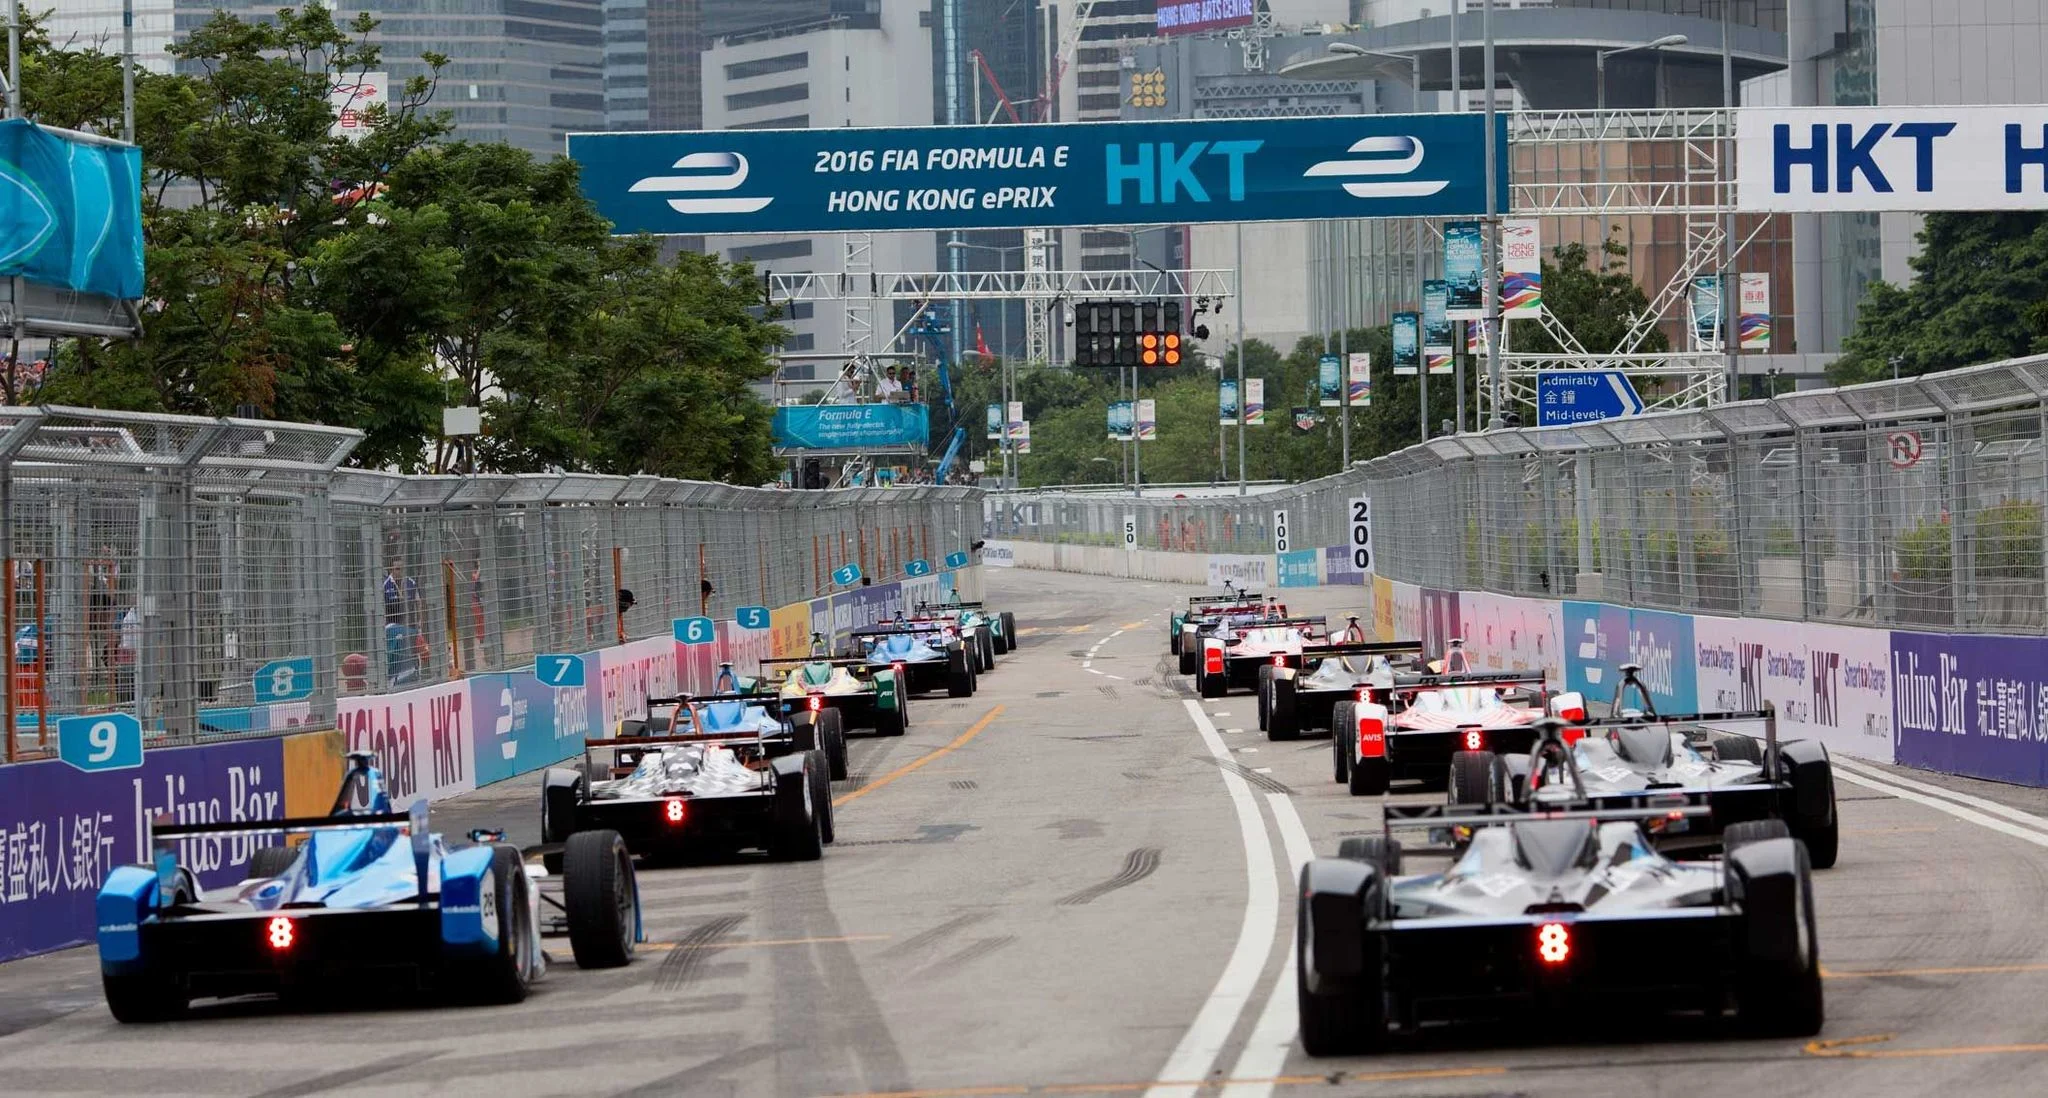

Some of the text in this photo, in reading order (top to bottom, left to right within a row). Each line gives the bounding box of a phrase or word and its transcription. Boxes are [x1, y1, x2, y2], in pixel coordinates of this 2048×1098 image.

[1157, 0, 1253, 28] HONG KONG ARTS CENTRE
[814, 145, 1069, 173] 2016 FIA FORMULA E
[1773, 122, 1958, 194] HKT
[1106, 140, 1265, 205] HKT
[828, 186, 1057, 213] HONG KONG ePRIX
[1542, 375, 1599, 387] Admiralty
[1543, 390, 1576, 404] 金鐘
[819, 408, 872, 421] Formula E
[1545, 408, 1606, 420] Mid-levels
[1125, 522, 1135, 544] 50
[1277, 512, 1287, 551] 100
[1353, 501, 1370, 569] 200
[913, 562, 923, 575] 2
[952, 554, 959, 564] 1
[842, 567, 853, 581] 3
[687, 620, 702, 640] 6
[748, 609, 761, 626] 5
[272, 666, 294, 696] 8
[553, 658, 572, 682] 7
[1739, 642, 1763, 711] HKT
[1767, 649, 1806, 687] Smart Charge
[1844, 658, 1886, 698] Smart Charge
[1811, 650, 1840, 728] HKT
[1894, 650, 1968, 747] Julius Bär
[88, 721, 117, 762] 9
[354, 702, 417, 808] Global
[430, 692, 463, 788] HKT
[1362, 732, 1383, 742] AVIS
[228, 764, 278, 866] Bär
